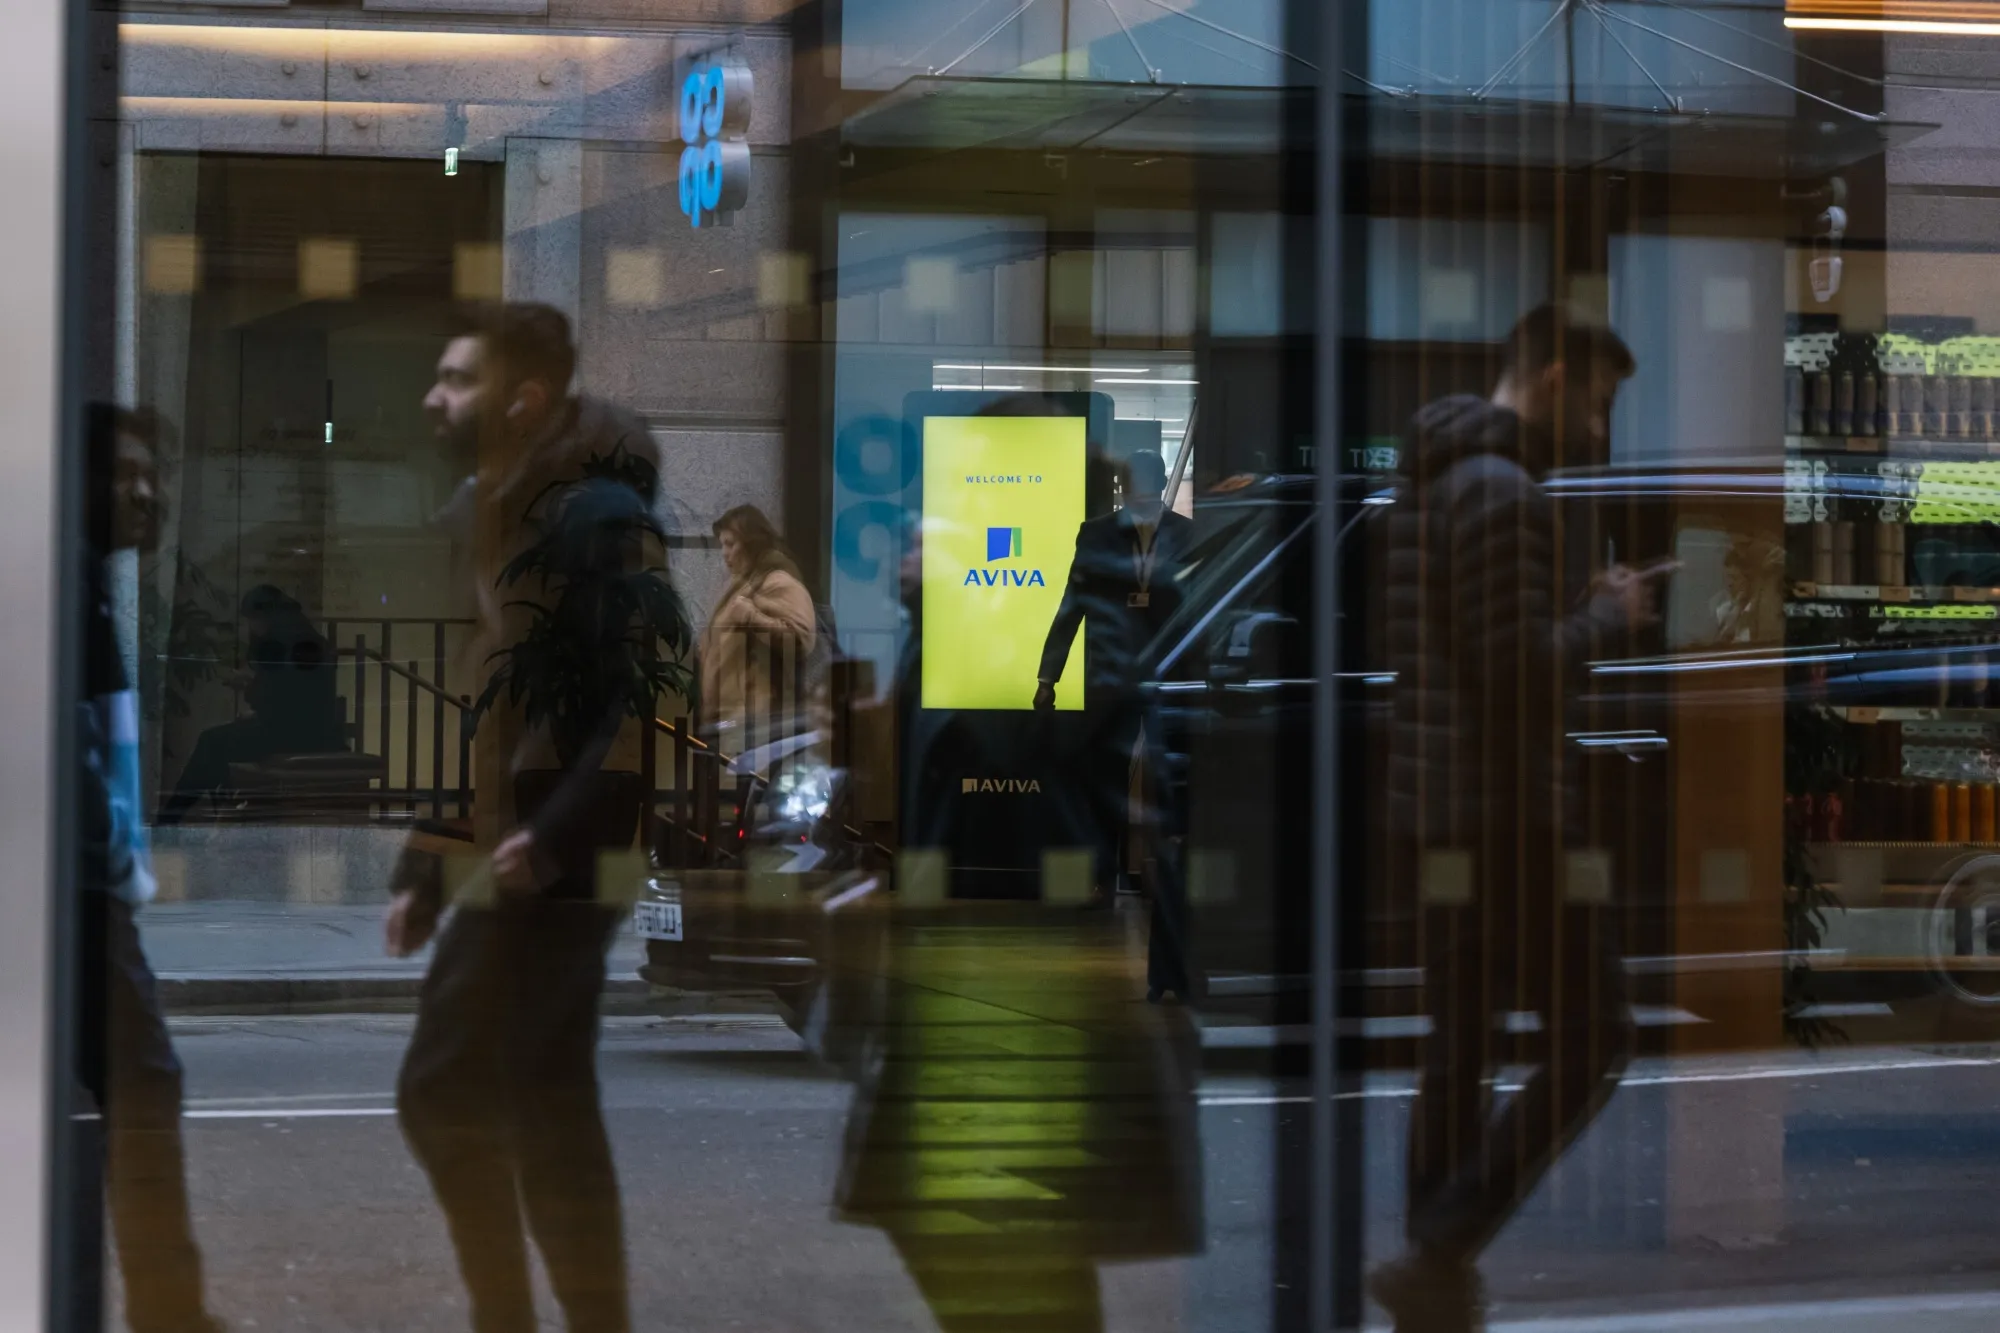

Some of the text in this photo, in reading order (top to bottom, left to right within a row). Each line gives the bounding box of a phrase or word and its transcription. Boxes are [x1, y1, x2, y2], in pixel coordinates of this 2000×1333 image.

[965, 475, 1043, 484] WELCOME TO
[964, 569, 1046, 587] AVIVA
[980, 779, 1041, 793] AVIVA
